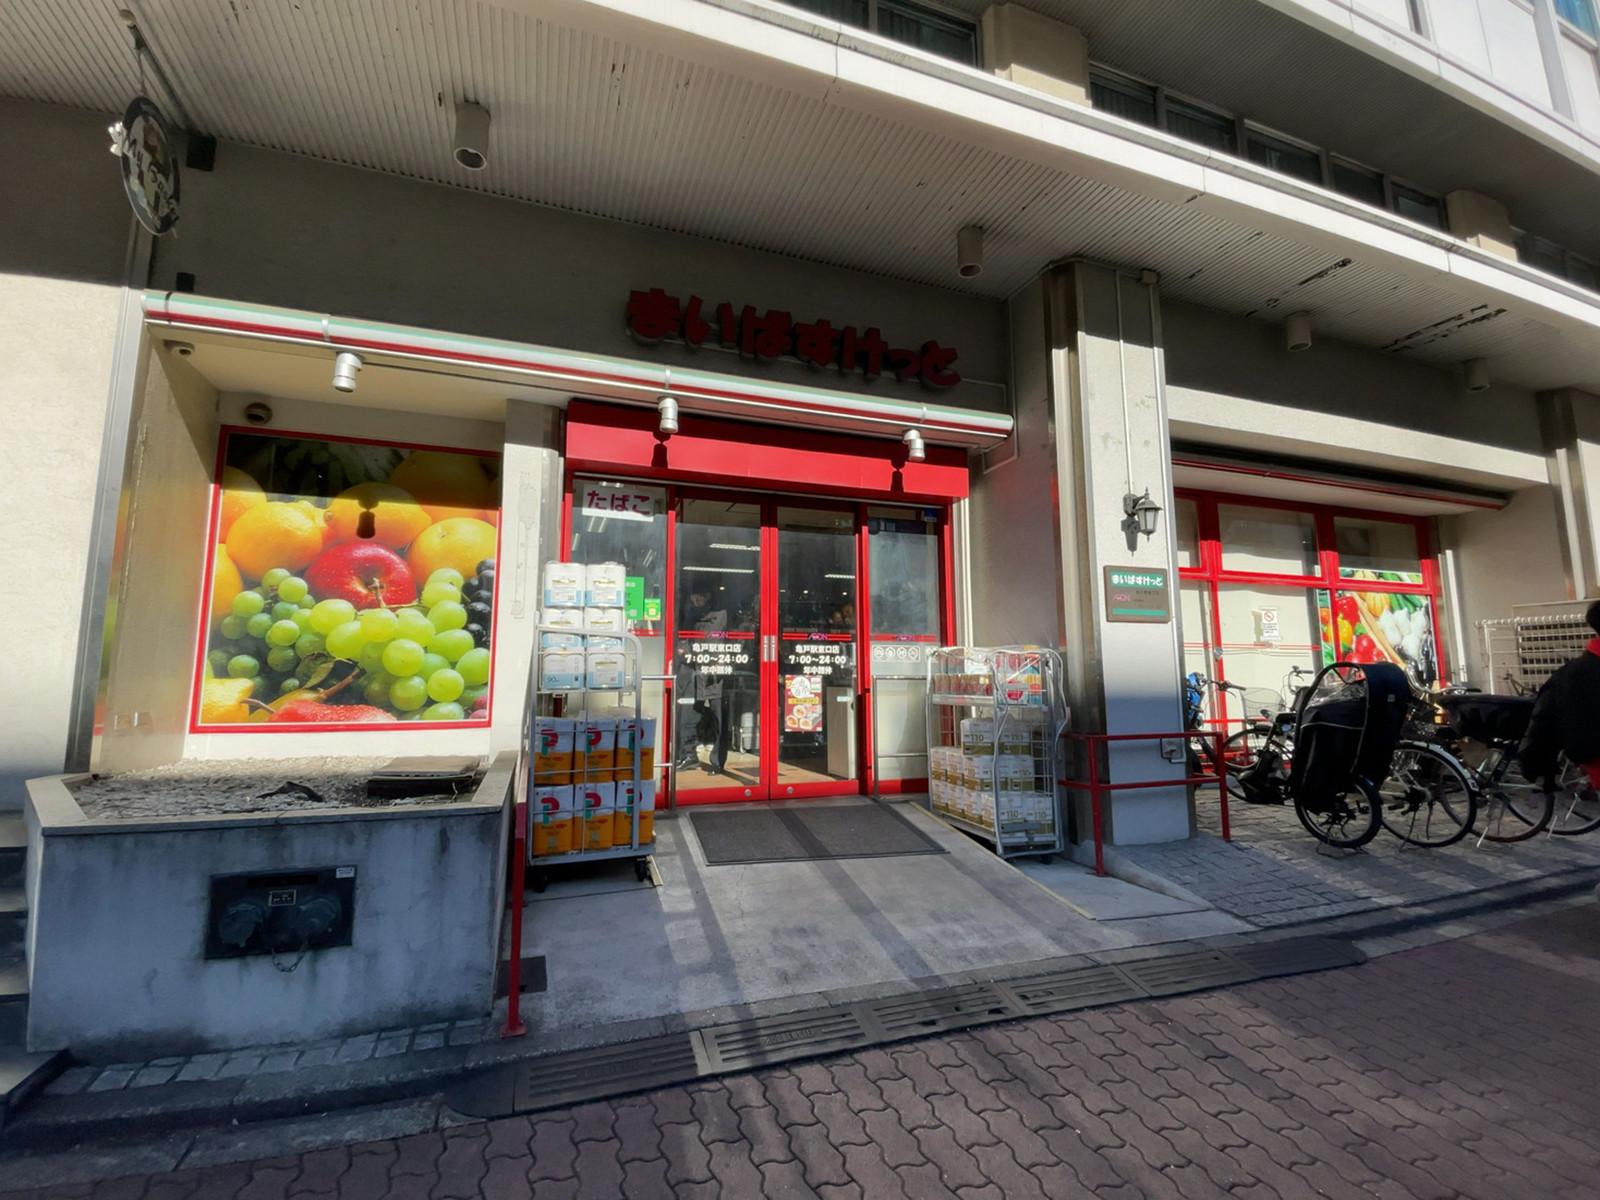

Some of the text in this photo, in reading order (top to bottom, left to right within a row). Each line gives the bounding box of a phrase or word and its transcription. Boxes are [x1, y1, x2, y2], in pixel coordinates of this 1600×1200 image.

[626, 287, 962, 389] まいばすけっと
[587, 490, 651, 515] たばこ
[1111, 574, 1163, 586] まいばすけっと
